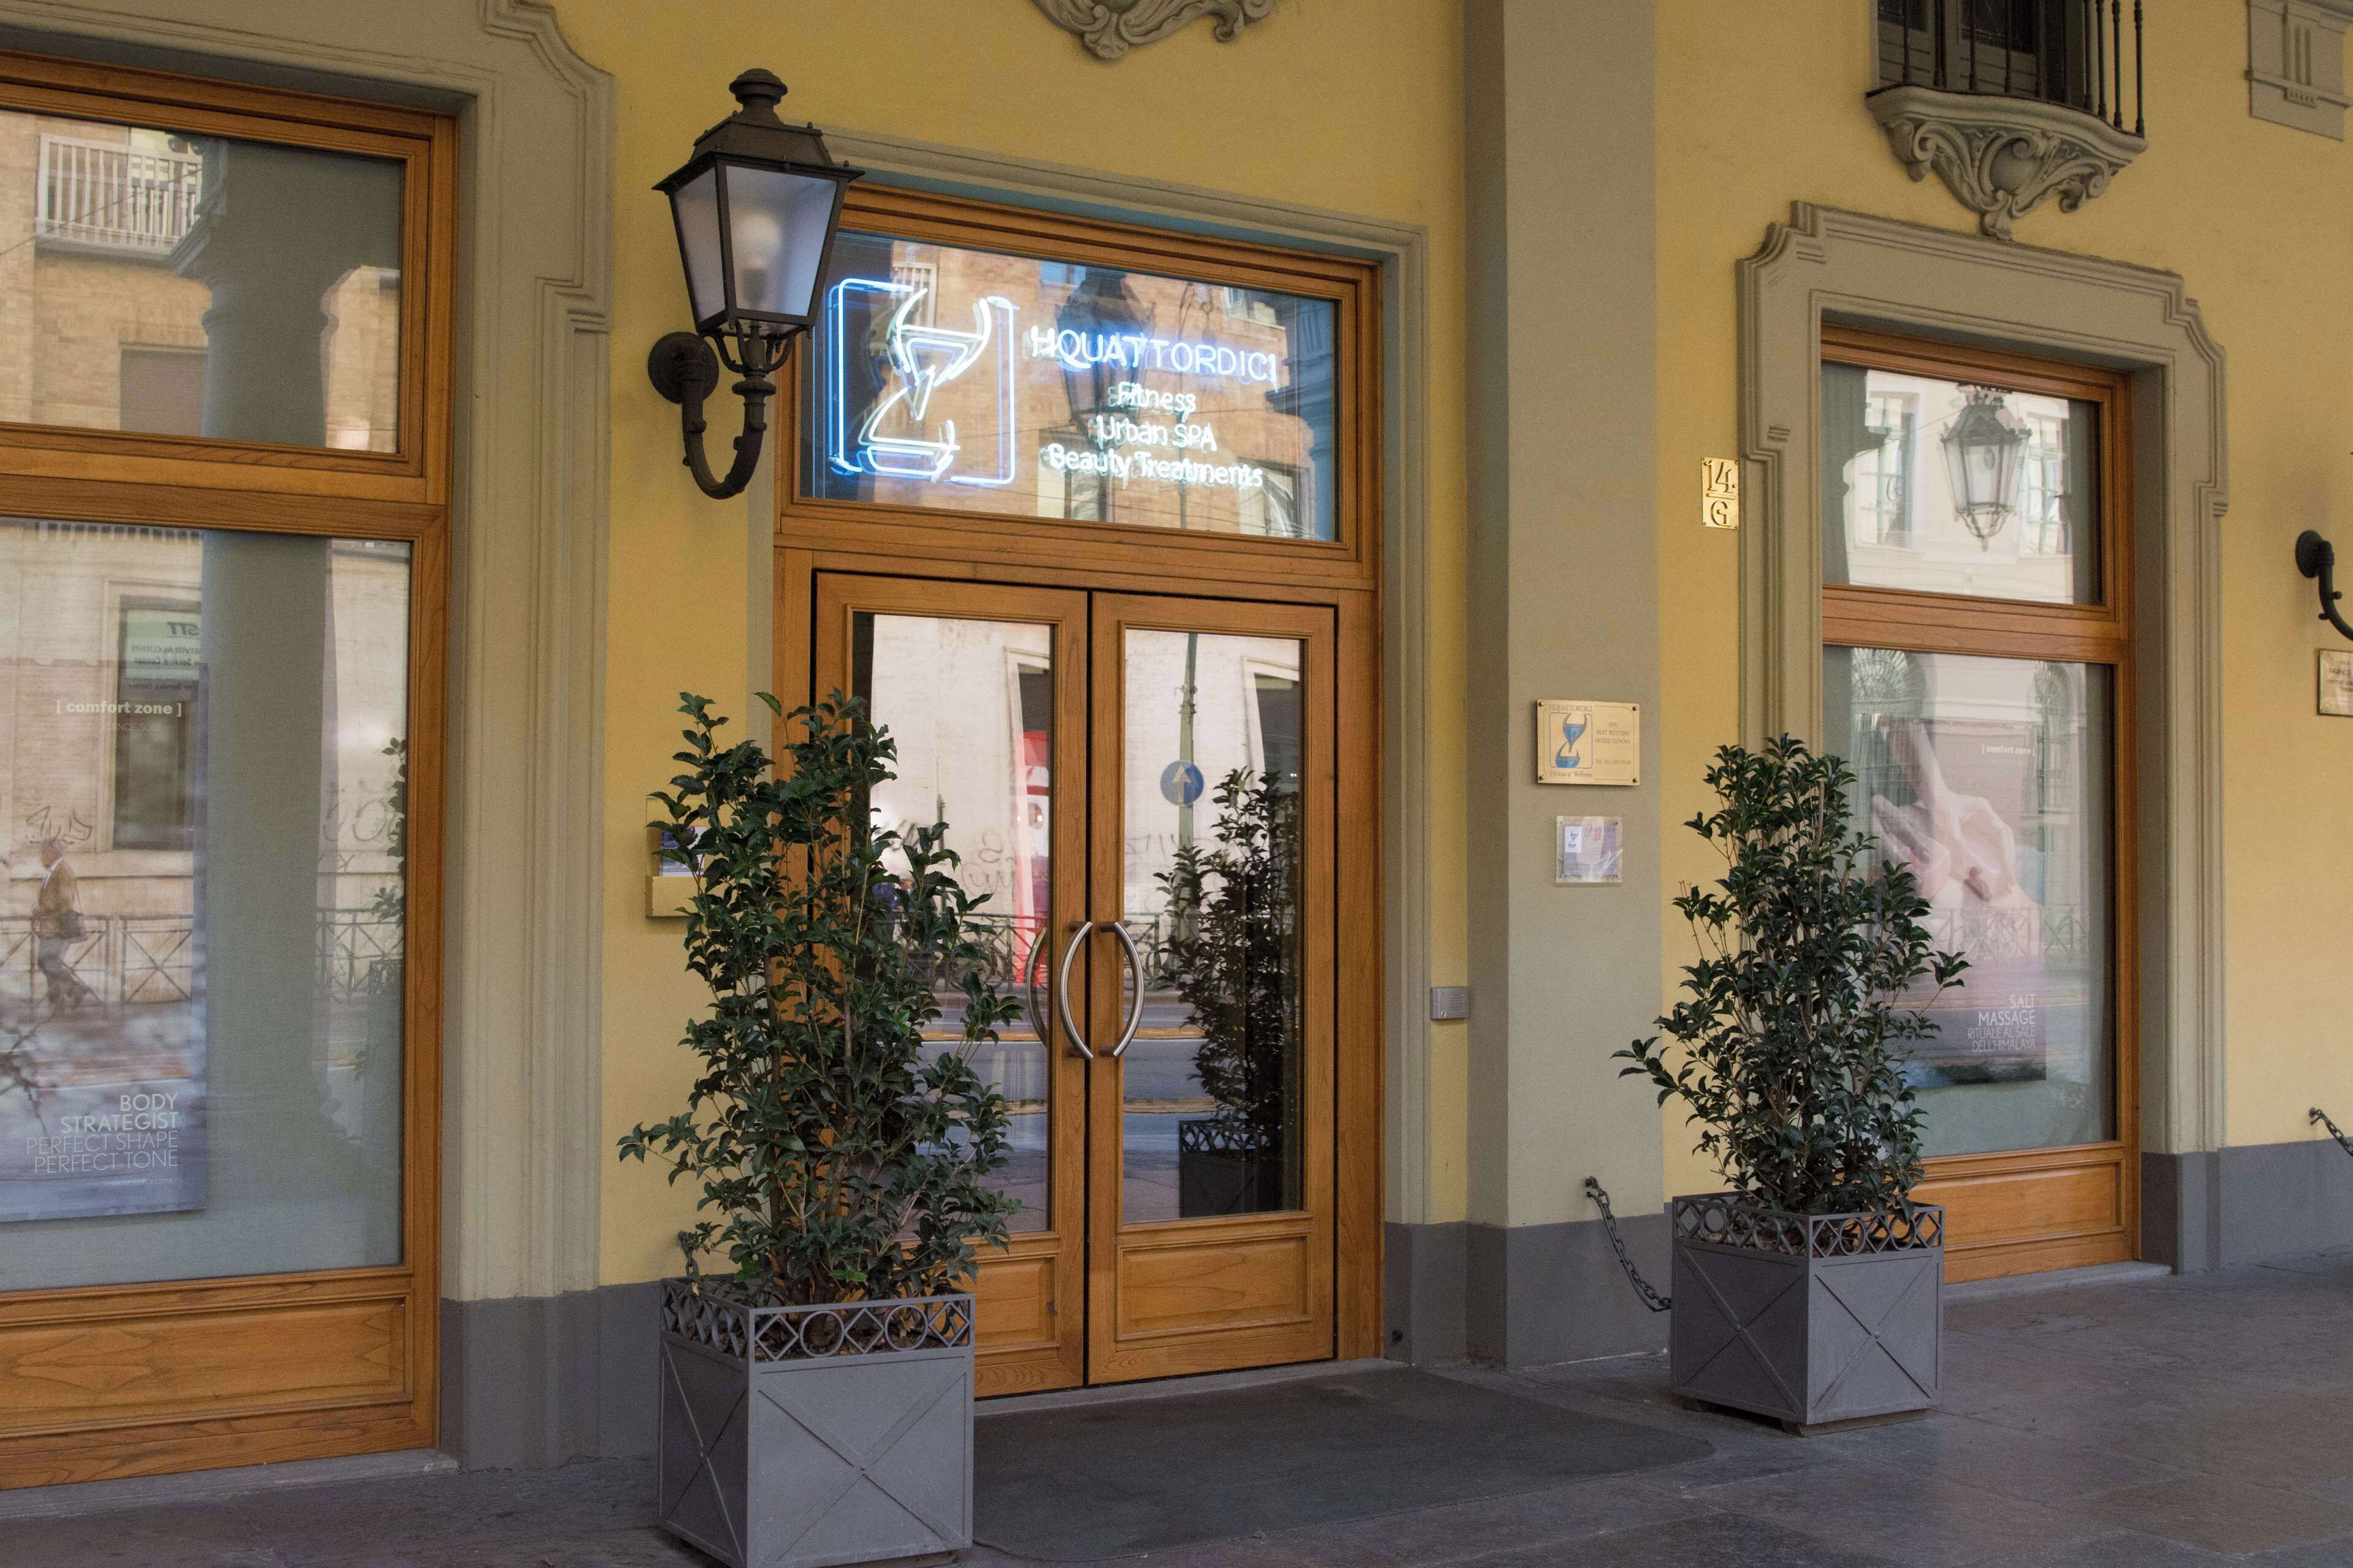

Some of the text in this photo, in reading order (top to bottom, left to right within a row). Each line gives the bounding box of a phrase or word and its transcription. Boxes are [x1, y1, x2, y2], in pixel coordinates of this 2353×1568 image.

[1117, 381, 1196, 414] Fitness
[1096, 415, 1217, 452] Urban SPA
[1047, 443, 1263, 488] Beauty Treatments
[1710, 499, 1732, 528] G
[66, 700, 131, 714] comfort
[134, 704, 173, 714] zone
[2010, 994, 2036, 1009] SALT
[1979, 1010, 2036, 1026] MASSAGE
[1967, 1026, 2036, 1039] RITUALE AL SALE
[120, 1093, 178, 1112] BODY
[61, 1112, 178, 1134] STRATEGIST
[26, 1131, 178, 1155] PERFECT SHAPE
[34, 1149, 178, 1173] PERFECT TONE
